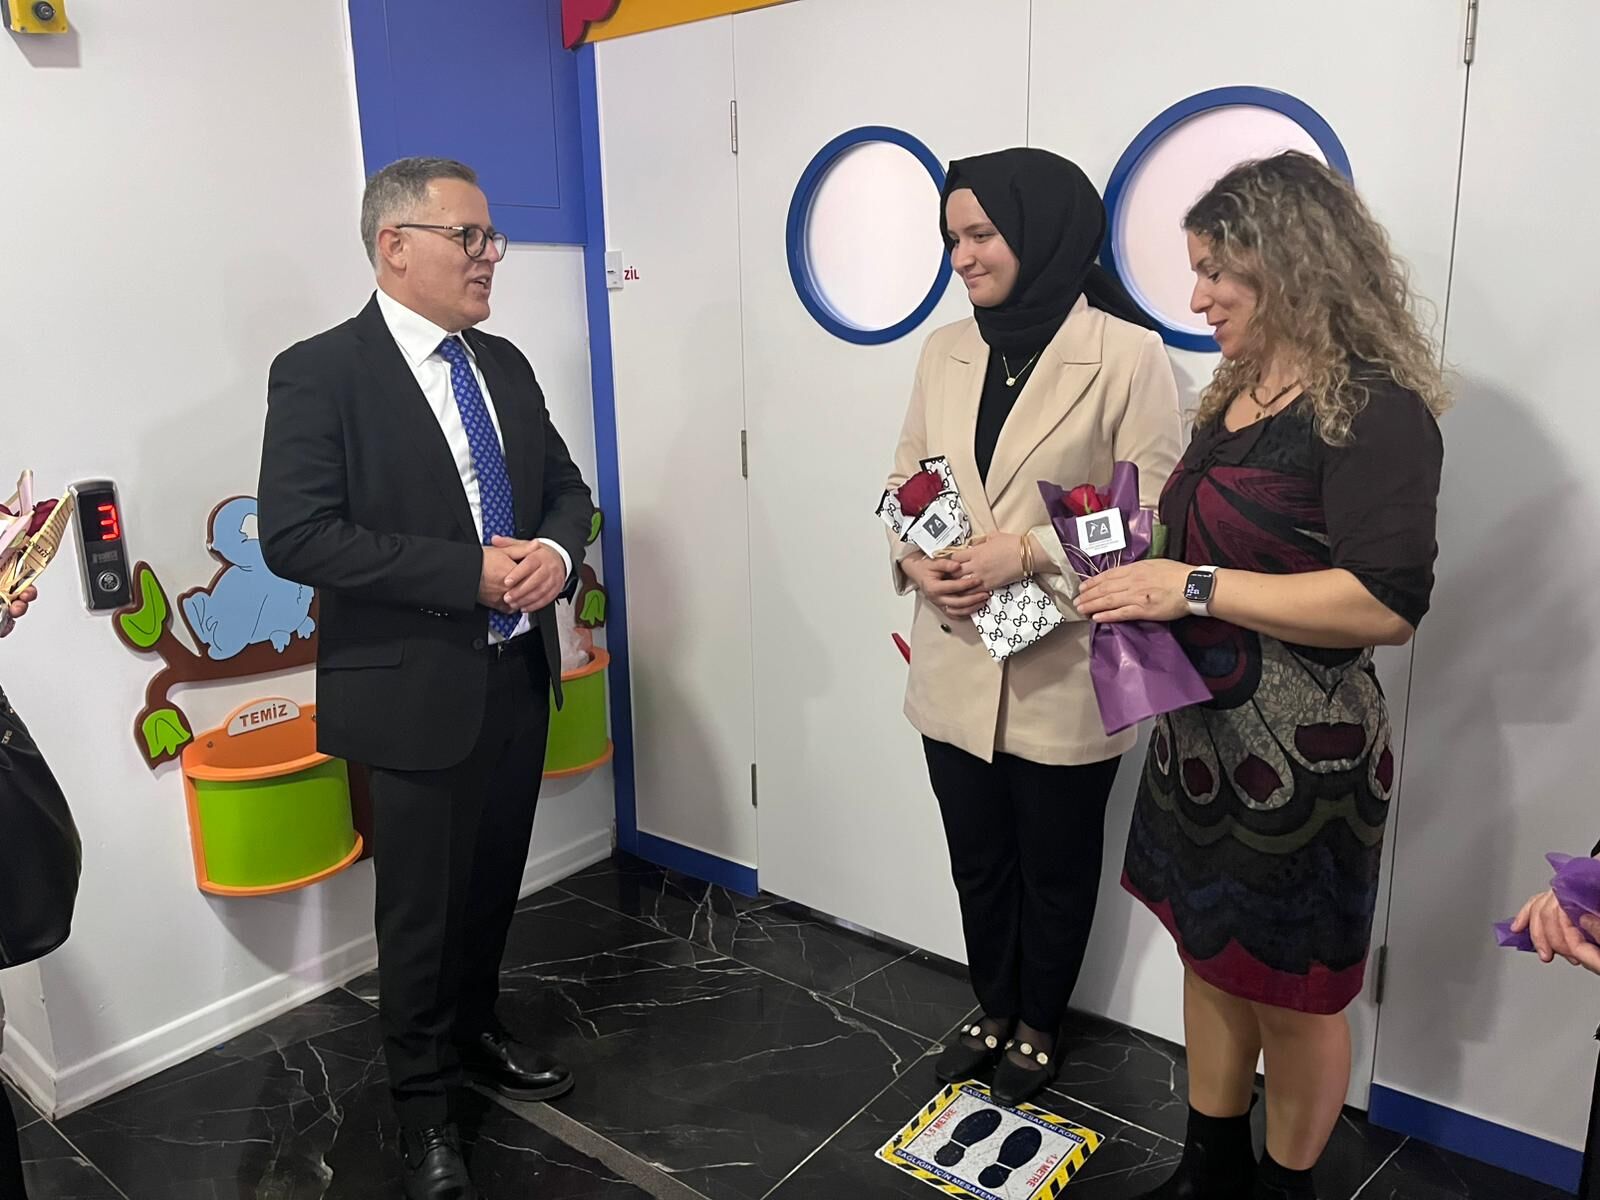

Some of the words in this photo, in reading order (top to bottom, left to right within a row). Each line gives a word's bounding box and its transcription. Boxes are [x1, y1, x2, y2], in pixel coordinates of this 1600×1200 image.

[624, 265, 640, 280] ZİL
[97, 504, 120, 540] 3
[239, 703, 288, 727] TEMİZ
[932, 1108, 957, 1129] METRE
[1058, 1129, 1084, 1143] KORU
[1026, 1164, 1051, 1187] METRE
